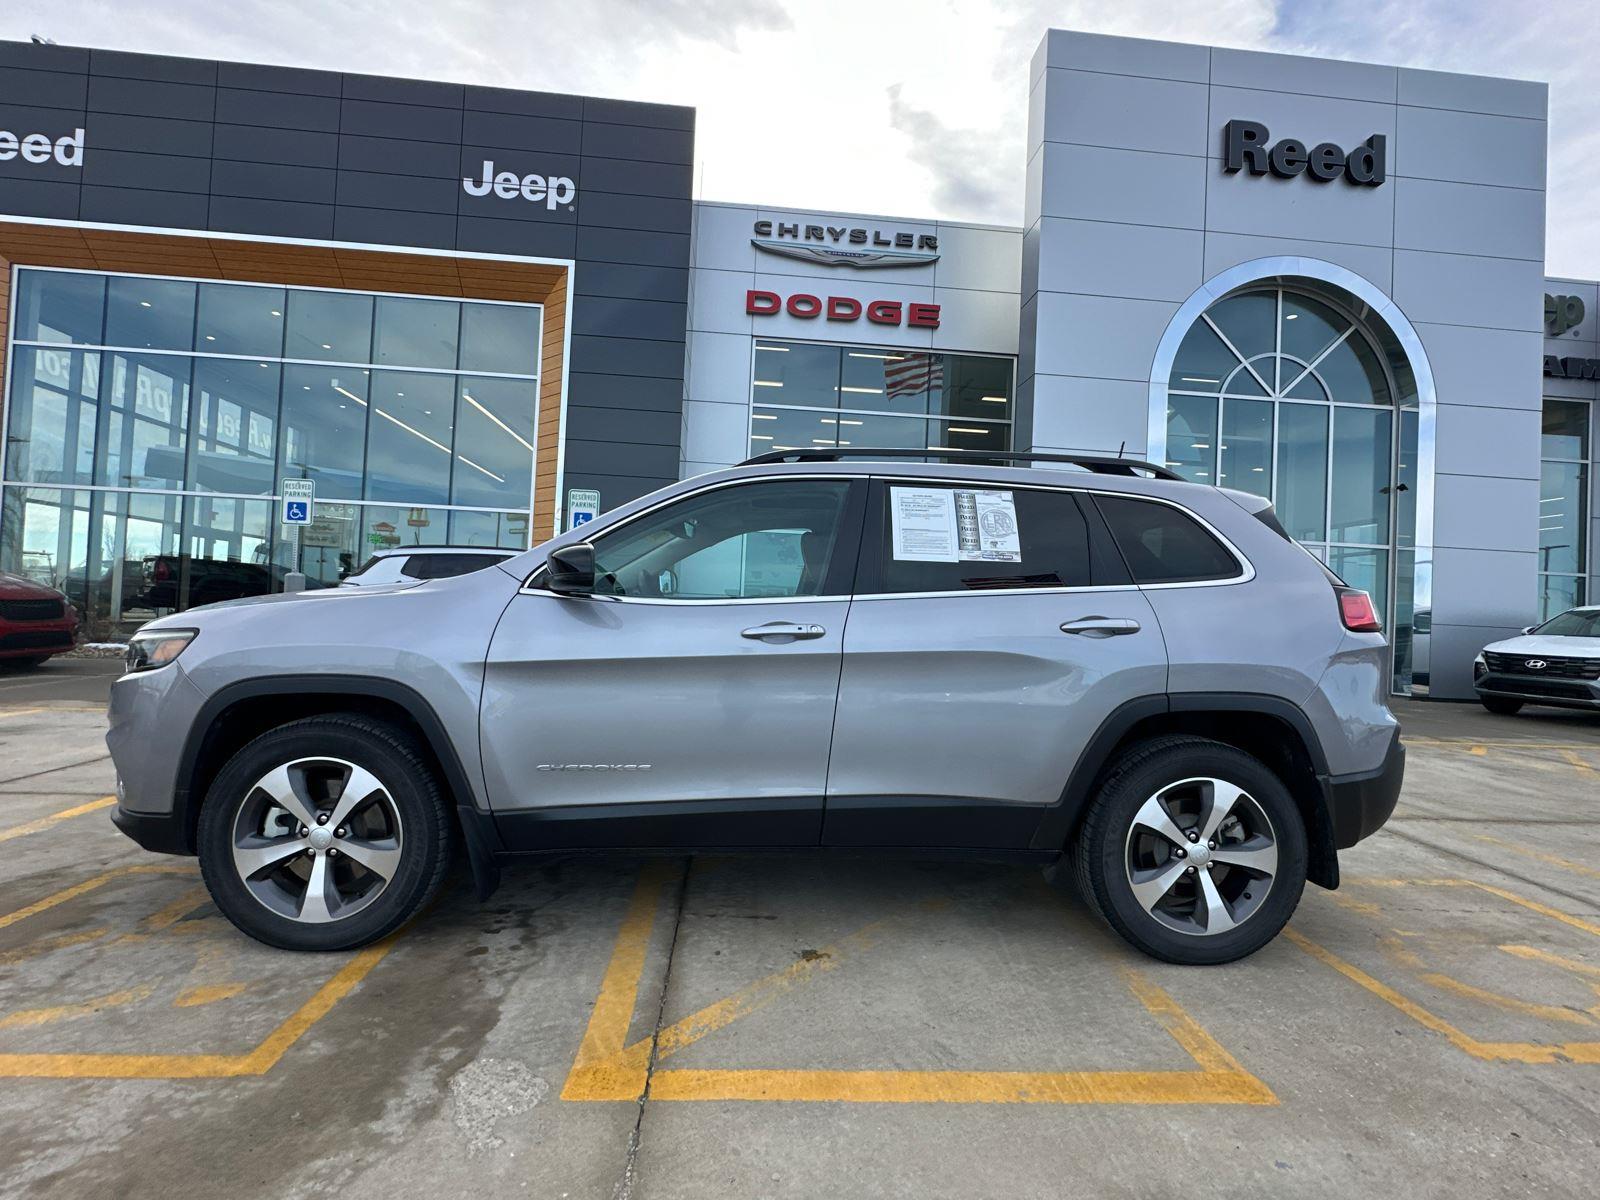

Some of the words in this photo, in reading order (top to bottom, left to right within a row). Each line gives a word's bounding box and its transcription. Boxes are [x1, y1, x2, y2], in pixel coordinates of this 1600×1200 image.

[0, 128, 85, 166] eed
[1224, 119, 1386, 187] Reed
[463, 160, 575, 210] Jeep
[754, 220, 938, 249] CHRYSLER
[746, 289, 941, 329] DODGE
[1543, 354, 1600, 379] AM
[285, 482, 312, 490] RESERVED
[572, 493, 597, 501] RESERVED
[571, 501, 596, 509] PARKING
